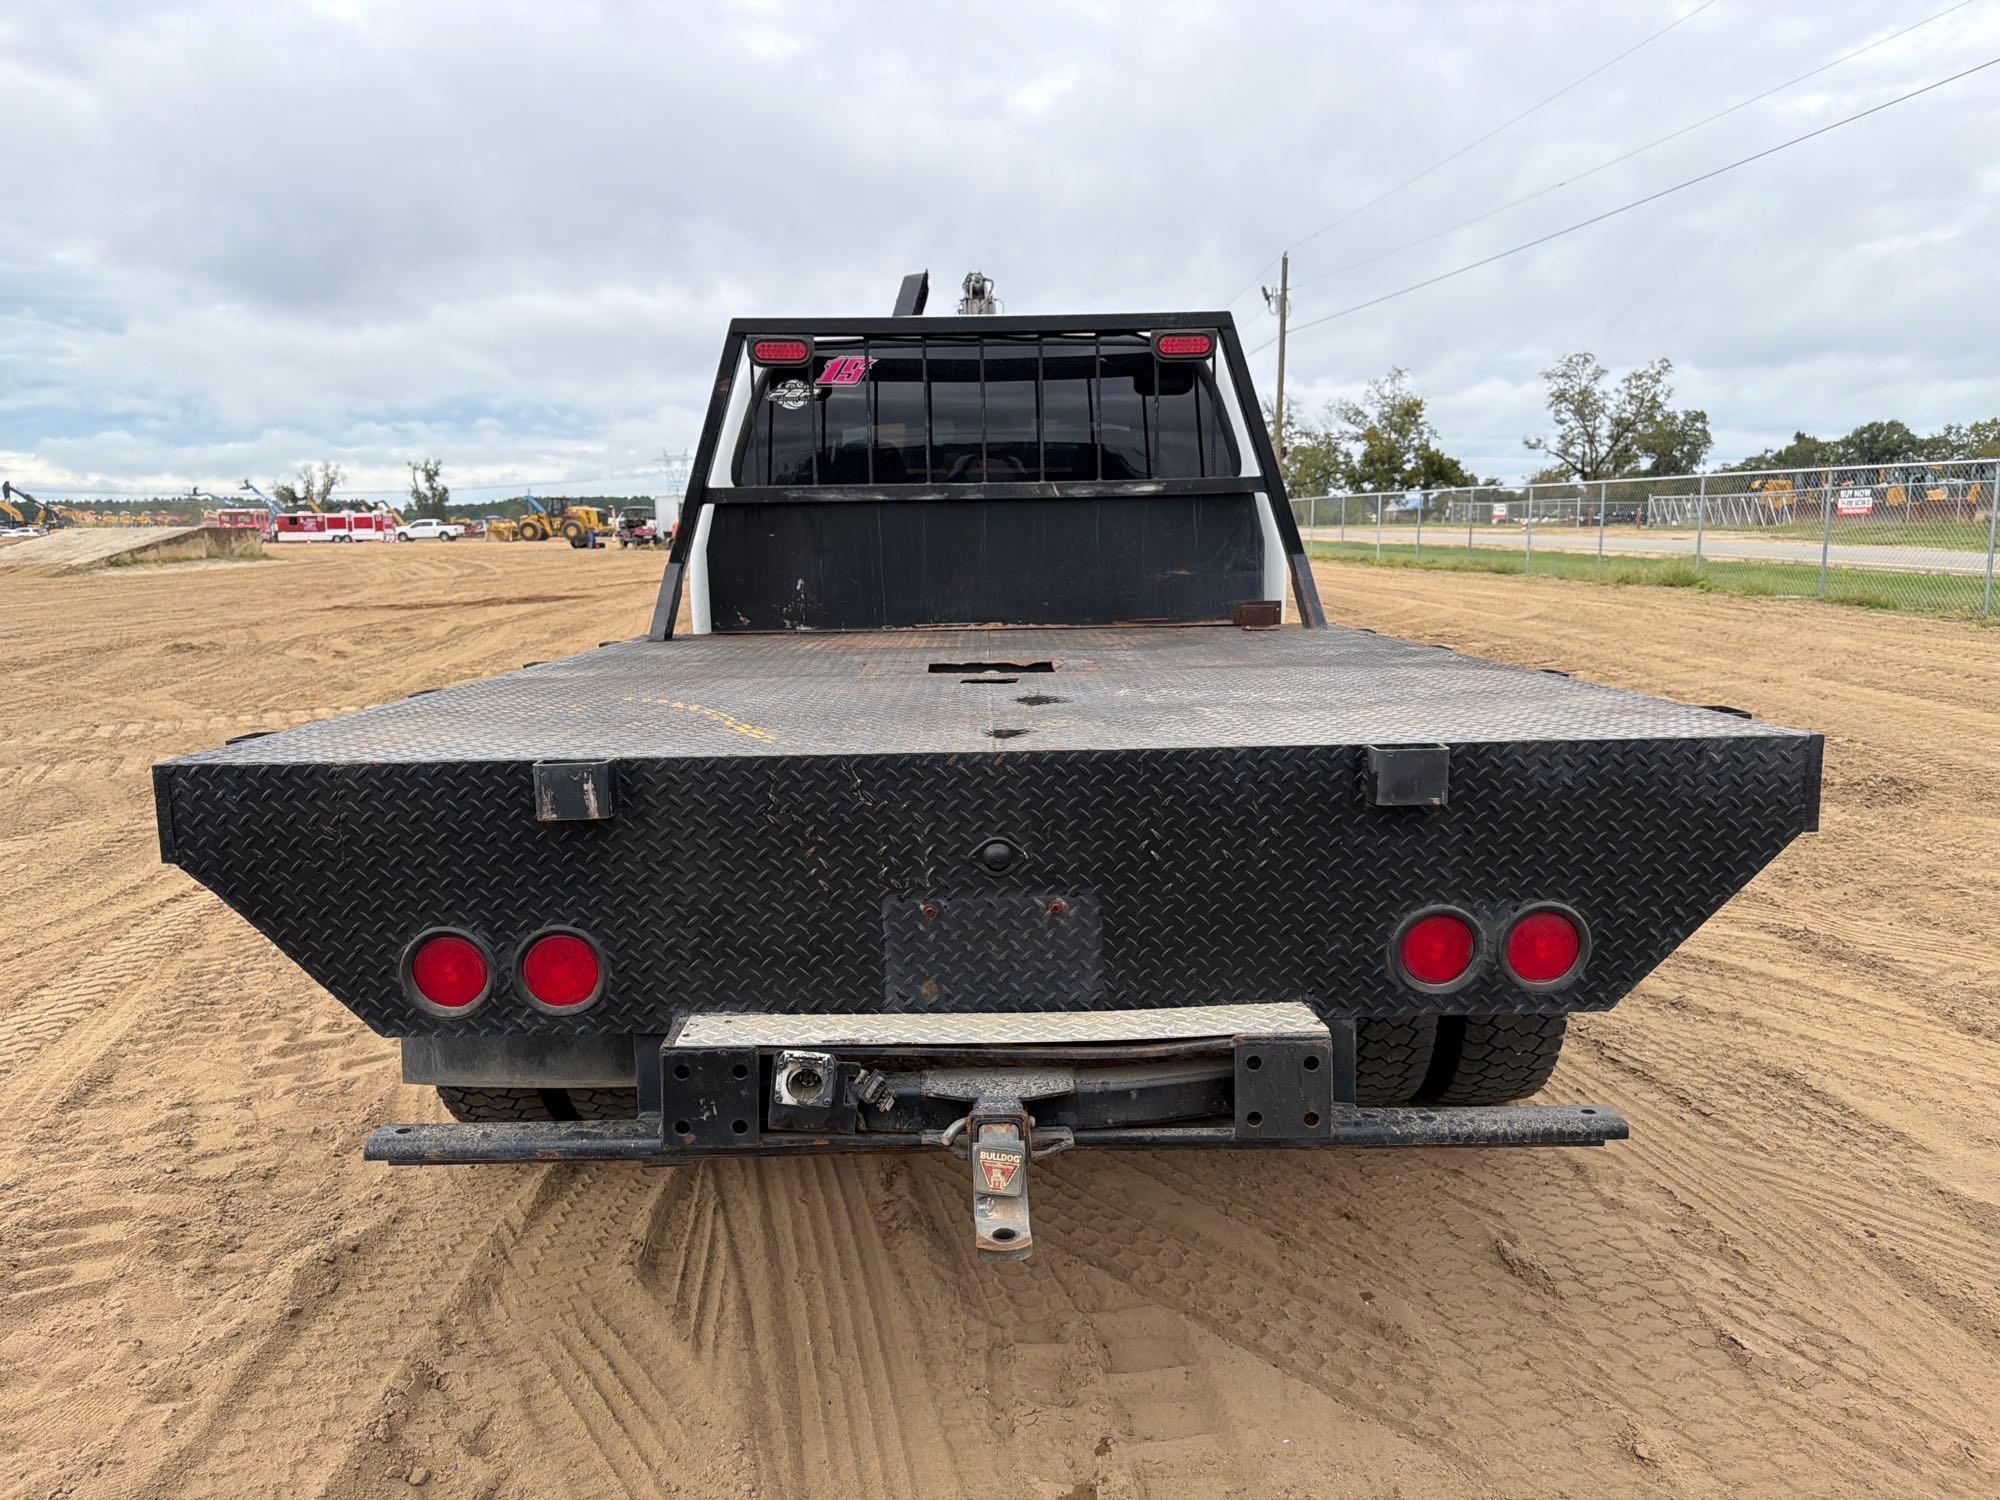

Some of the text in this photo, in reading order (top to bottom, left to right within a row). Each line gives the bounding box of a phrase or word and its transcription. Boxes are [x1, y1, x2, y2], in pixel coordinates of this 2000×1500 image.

[1840, 488, 1872, 498] BUY NOW
[980, 1151, 1021, 1163] BULLDOG
